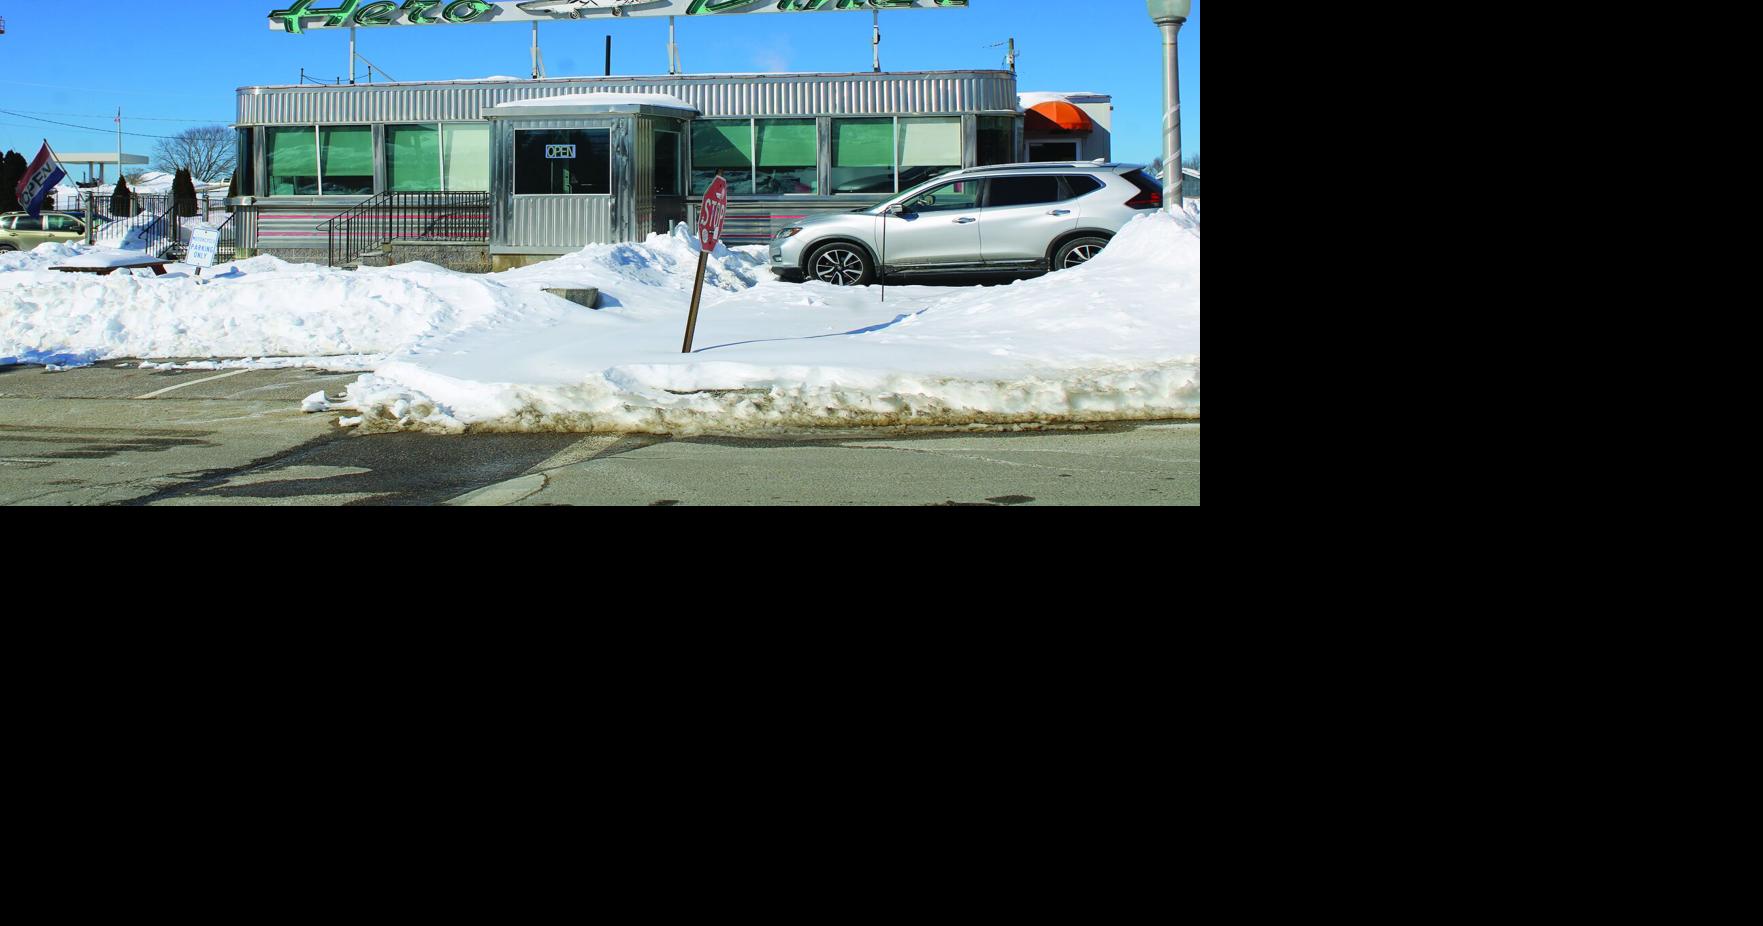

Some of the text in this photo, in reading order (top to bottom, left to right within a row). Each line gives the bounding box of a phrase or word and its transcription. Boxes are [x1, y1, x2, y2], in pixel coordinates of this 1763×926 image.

[546, 145, 574, 157] OPEN
[22, 162, 52, 205] OPEN
[701, 198, 725, 228] STOP
[190, 243, 215, 253] PARKING
[193, 250, 208, 259] ONLY
